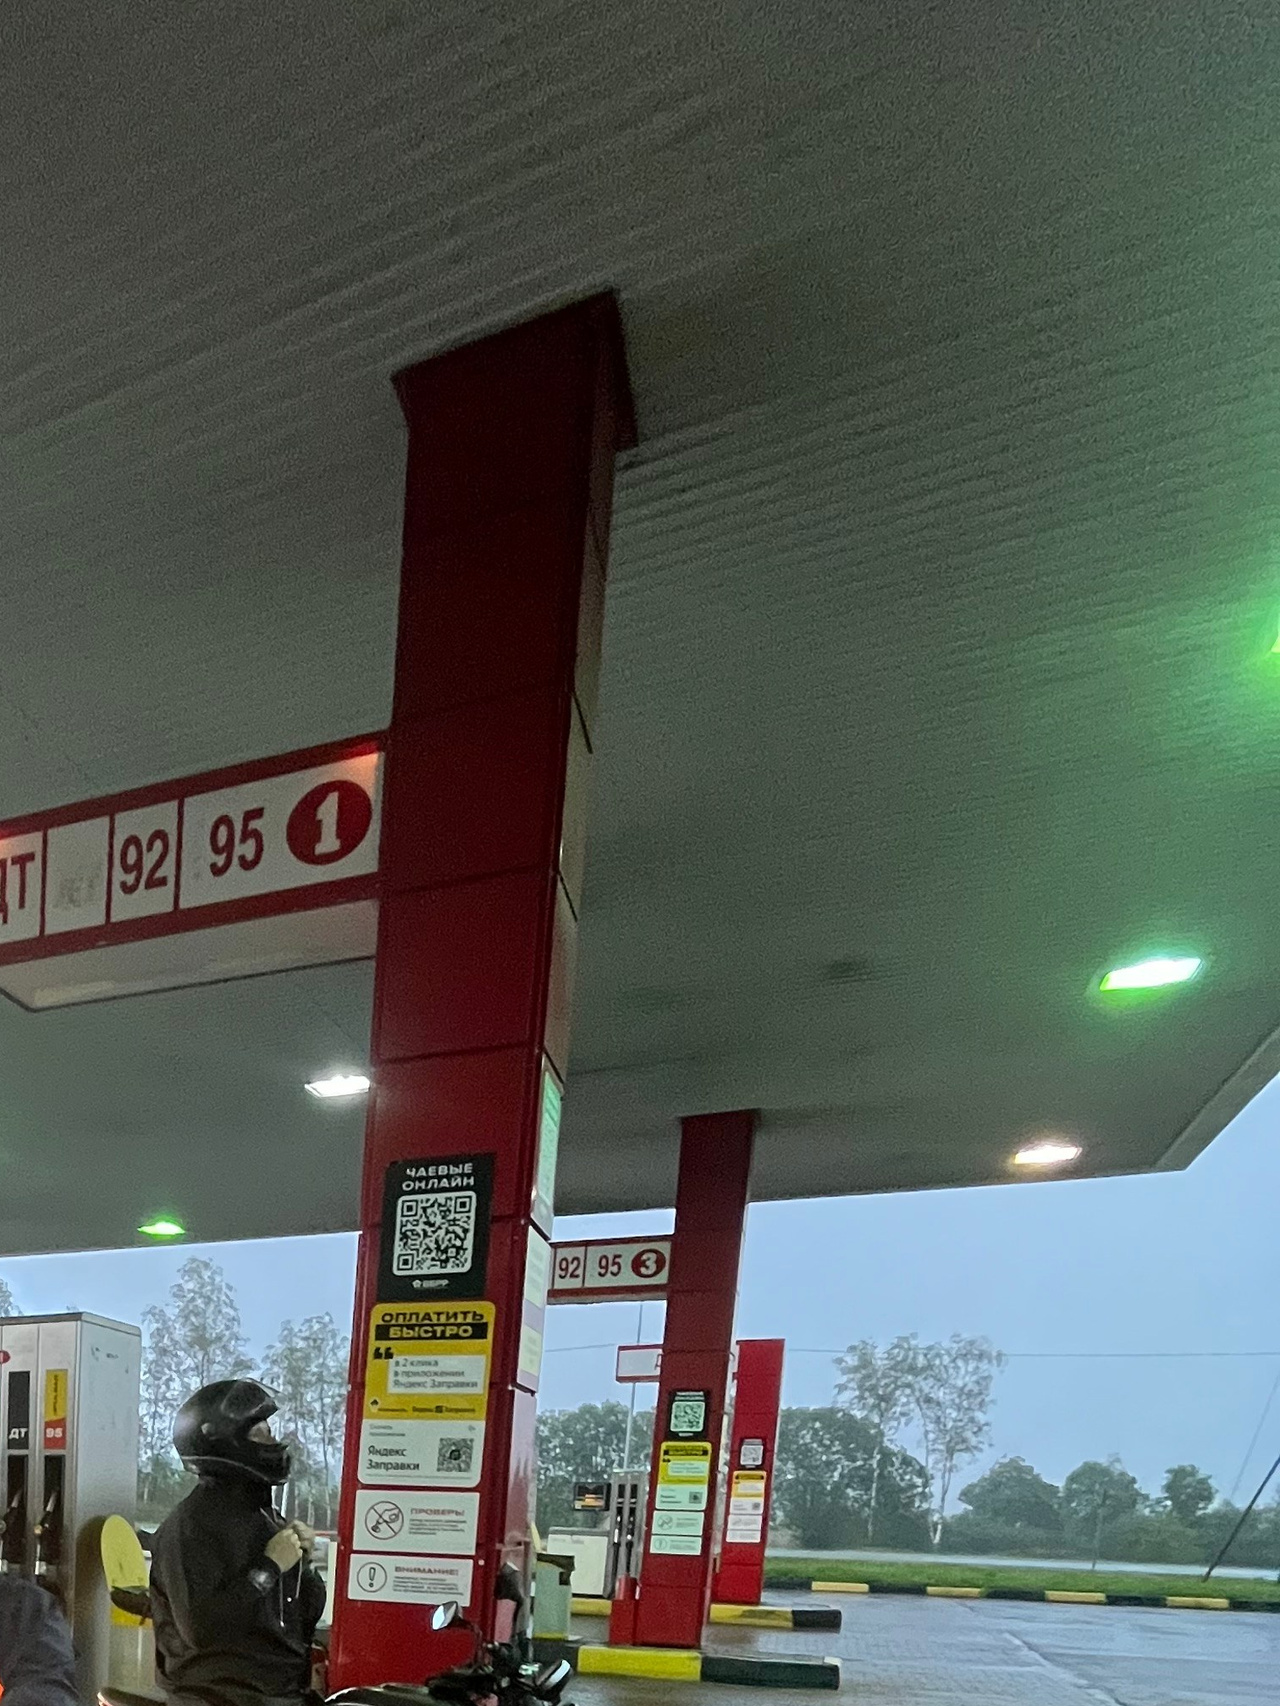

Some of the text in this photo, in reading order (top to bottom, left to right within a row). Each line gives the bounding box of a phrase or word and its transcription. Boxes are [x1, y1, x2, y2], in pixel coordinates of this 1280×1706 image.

[120, 829, 170, 895] 92
[209, 807, 265, 878] 95
[314, 791, 342, 856] 1
[405, 1162, 474, 1178] ЧАЕВЫЕ
[402, 1175, 475, 1191] ОНЛАЙН
[558, 1252, 657, 1279] 92 95 3
[381, 1311, 485, 1323] ОПЛАТИТЬ
[389, 1325, 473, 1338] БЫСТРО
[402, 1358, 409, 1367] 2
[9, 1427, 28, 1440] ДТ
[45, 1427, 63, 1438] 95
[367, 1445, 407, 1457] Яндекс
[366, 1459, 420, 1471] Заправки
